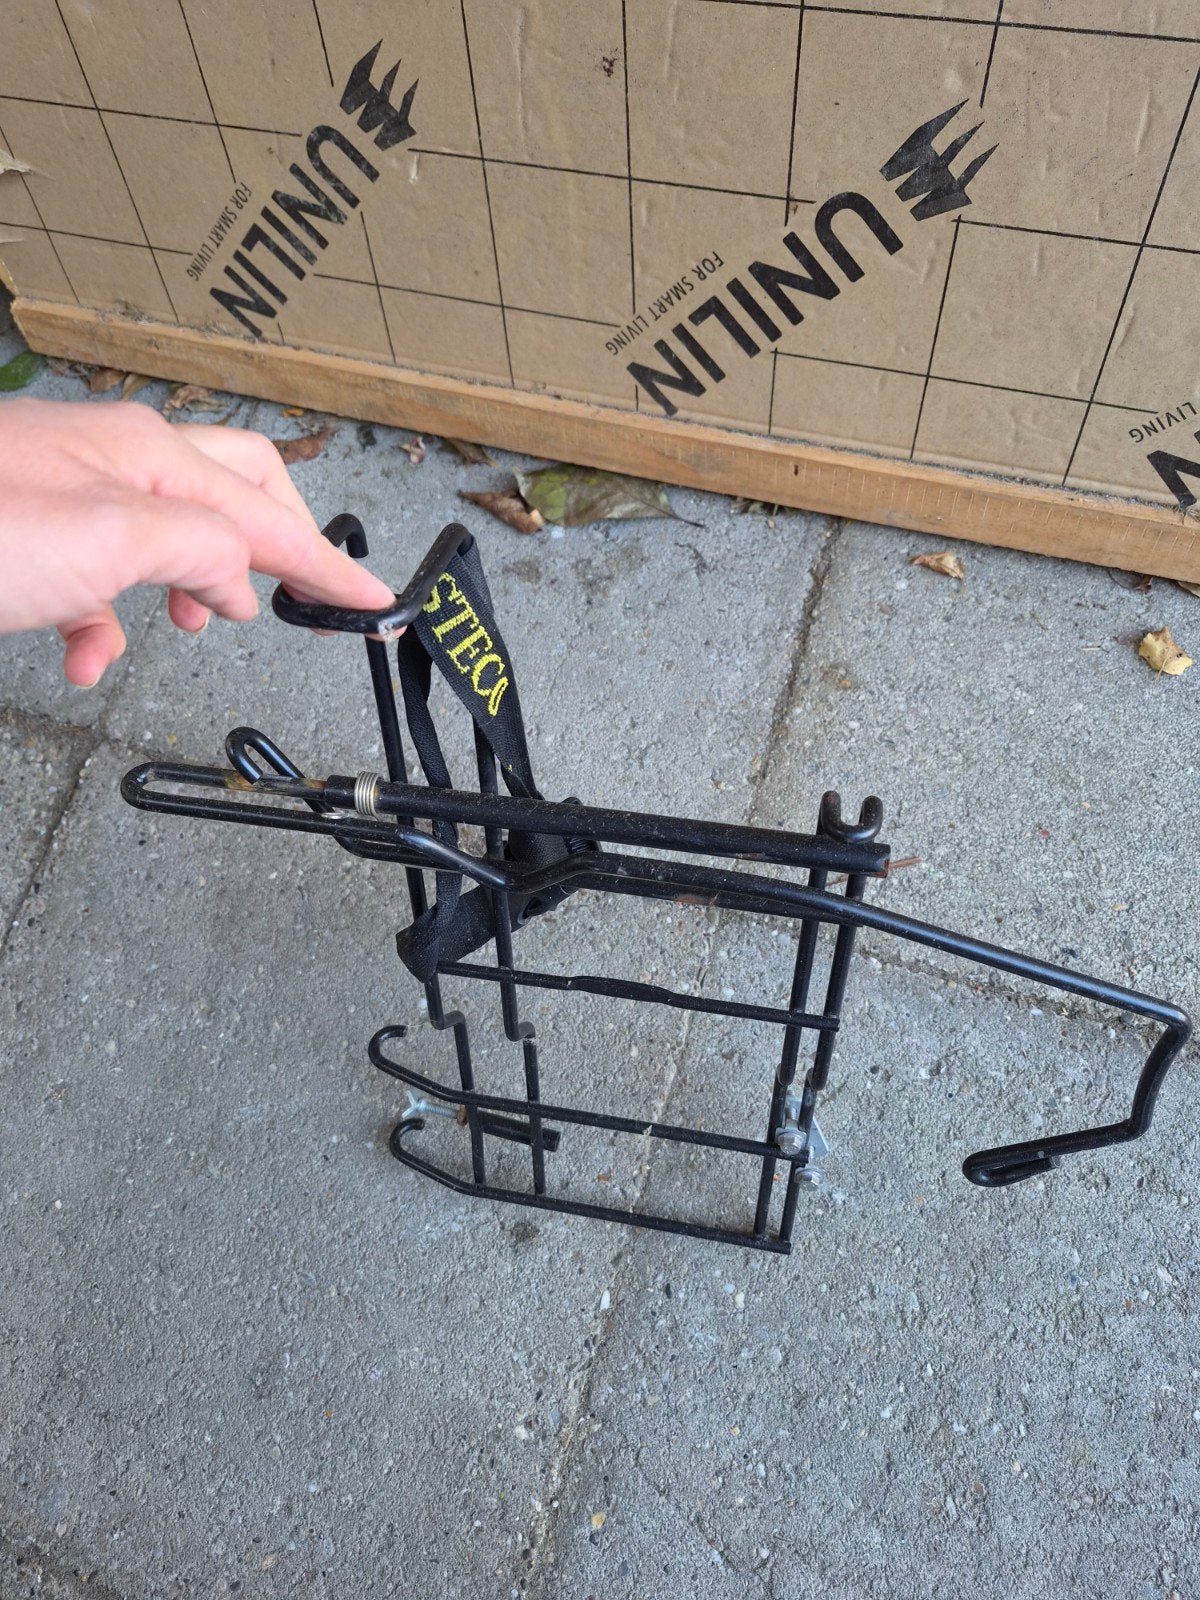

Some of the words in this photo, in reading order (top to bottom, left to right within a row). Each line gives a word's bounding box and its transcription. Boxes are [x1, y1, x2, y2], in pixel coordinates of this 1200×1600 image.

[229, 182, 252, 210] FOR
[208, 205, 238, 248] SMART
[209, 125, 380, 338] UNILIN
[186, 243, 215, 282] LIVING
[691, 251, 724, 281] FOR
[626, 191, 904, 417] UNILIN
[648, 276, 695, 322] SMART
[605, 315, 650, 356] LIVING
[1128, 401, 1198, 444] LIVING
